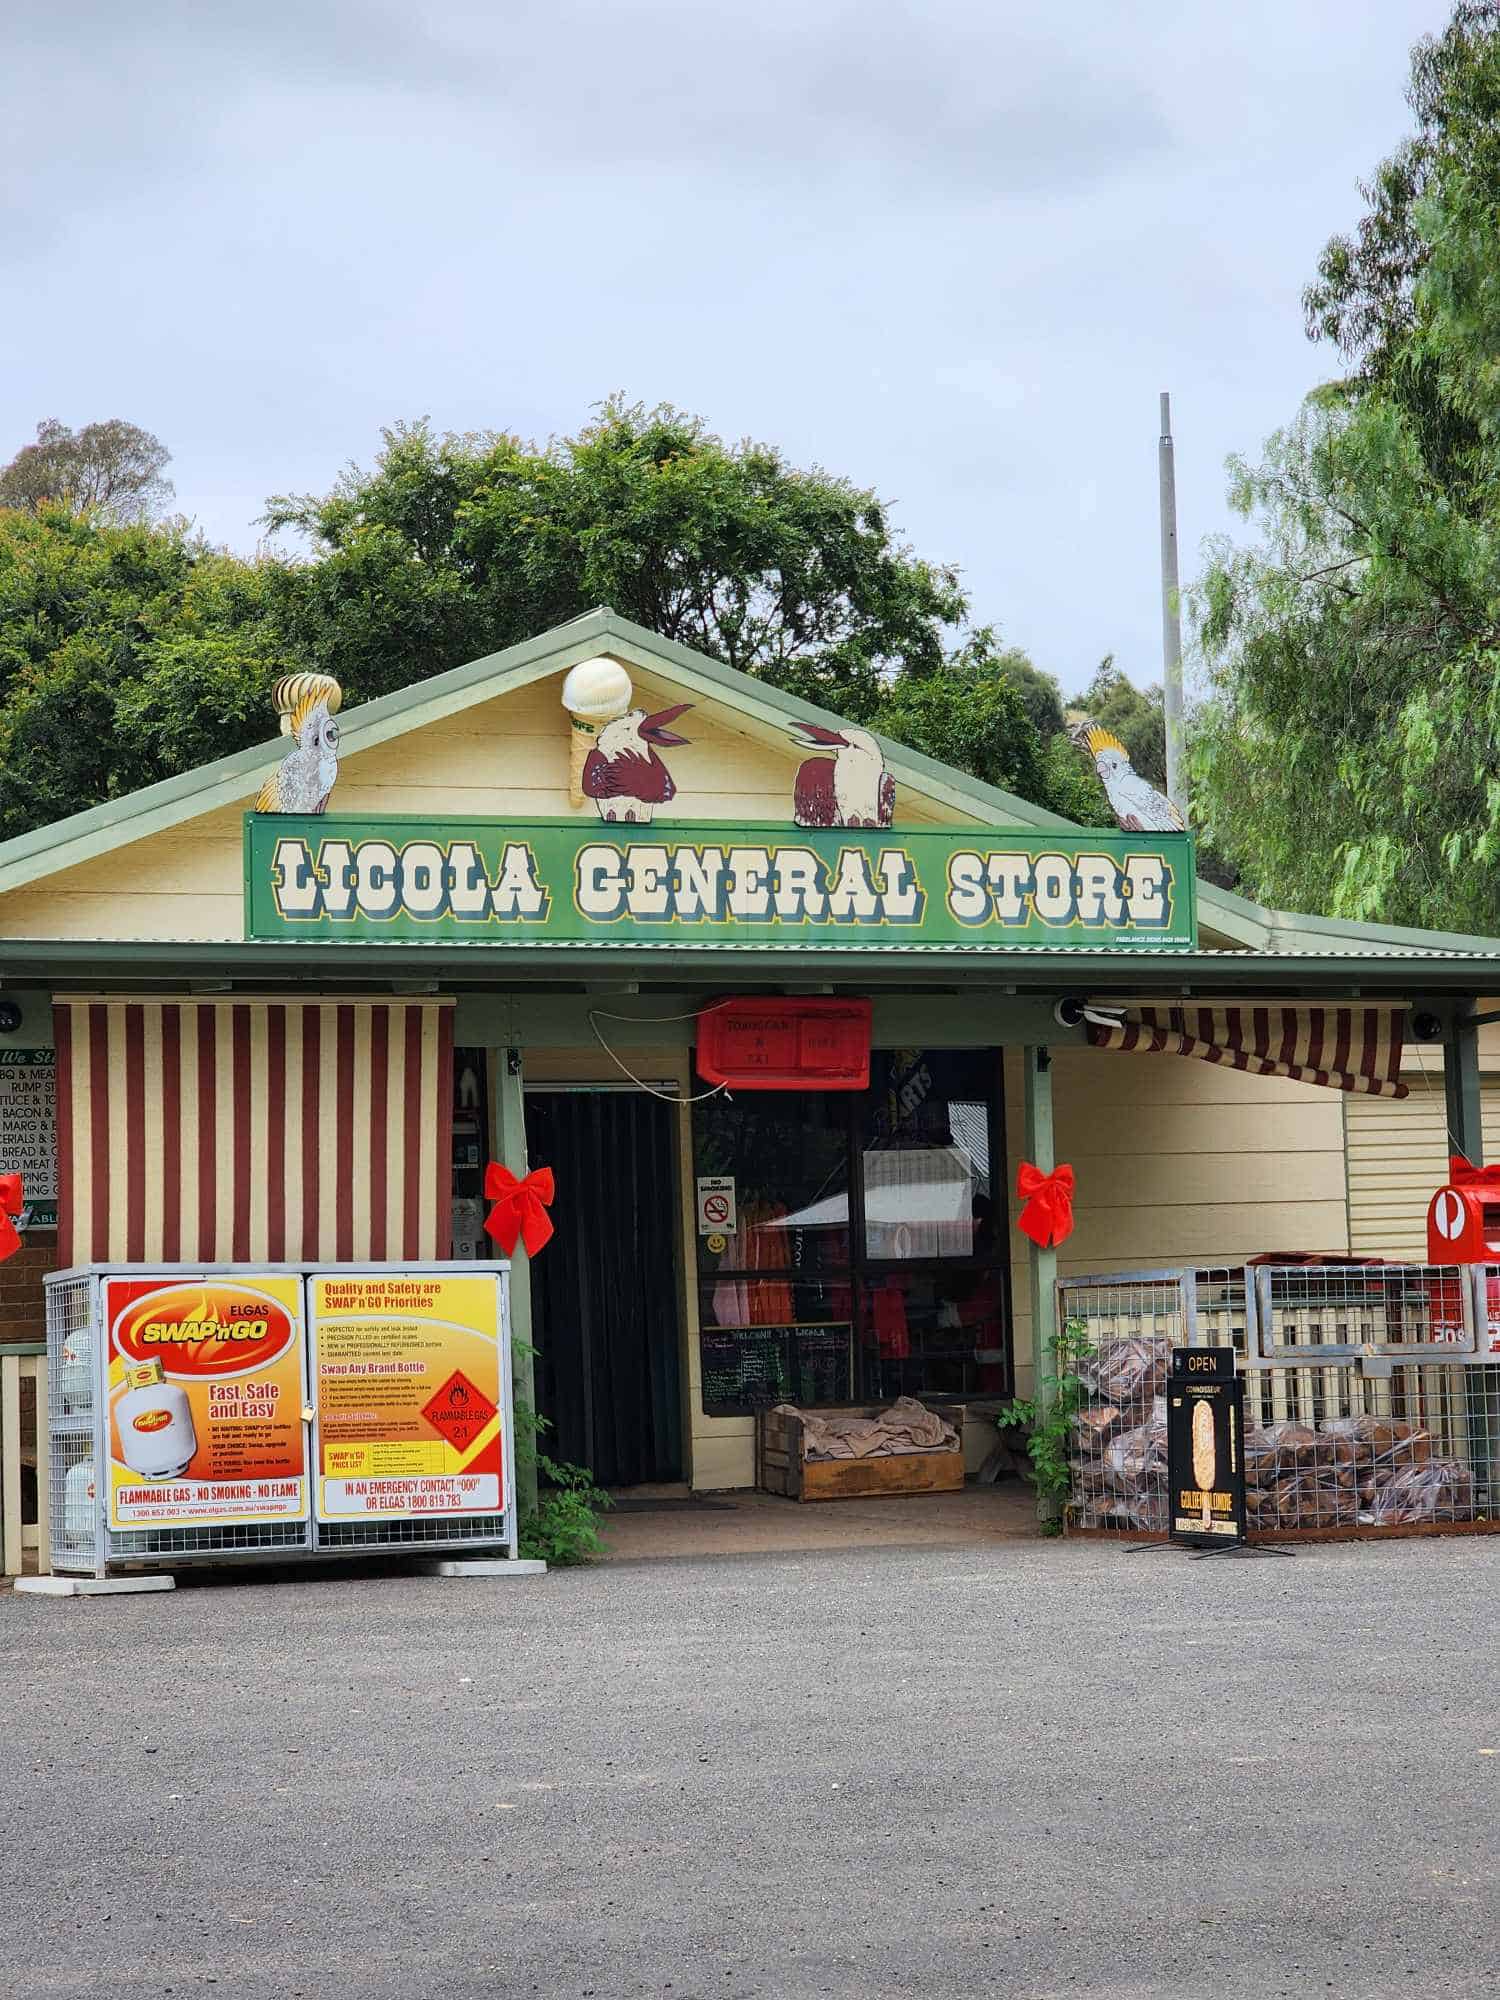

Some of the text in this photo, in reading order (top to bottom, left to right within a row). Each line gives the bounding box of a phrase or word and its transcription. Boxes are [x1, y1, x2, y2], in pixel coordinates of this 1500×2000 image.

[271, 838, 1175, 929] LICOLA GENERAL STORE
[2, 1051, 28, 1064] We
[18, 1070, 26, 1079] &
[11, 1082, 41, 1093] RUMP
[32, 1095, 41, 1105] &
[2, 1107, 52, 1119] BACON &
[3, 1120, 37, 1131] MARG
[40, 1120, 48, 1131] &
[38, 1133, 47, 1144] &
[2, 1146, 36, 1157] BREAD
[39, 1147, 47, 1157] &
[23, 1159, 50, 1170] MEAT
[325, 1282, 441, 1296] Quality and Safety are
[384, 1295, 433, 1308] Priorities
[230, 1305, 269, 1317] ELGAS
[321, 1362, 425, 1377] Swap Any Brand Bottle
[1188, 1356, 1217, 1372] OPEN
[246, 1383, 279, 1400] Safe
[210, 1401, 275, 1419] and Easy
[332, 1461, 349, 1470] PRICE
[120, 1490, 172, 1505] FLAMMABLE
[173, 1488, 191, 1502] GAS
[197, 1487, 209, 1501] NO
[211, 1485, 252, 1500] SMOKING
[258, 1484, 270, 1498] NO
[272, 1483, 298, 1497] FLAME
[345, 1485, 353, 1496] IN
[354, 1484, 368, 1496] AN
[369, 1481, 418, 1495] EMERGENCY
[420, 1480, 455, 1493] CONTACT
[366, 1494, 461, 1510] OR ELGAS 1800 819 783
